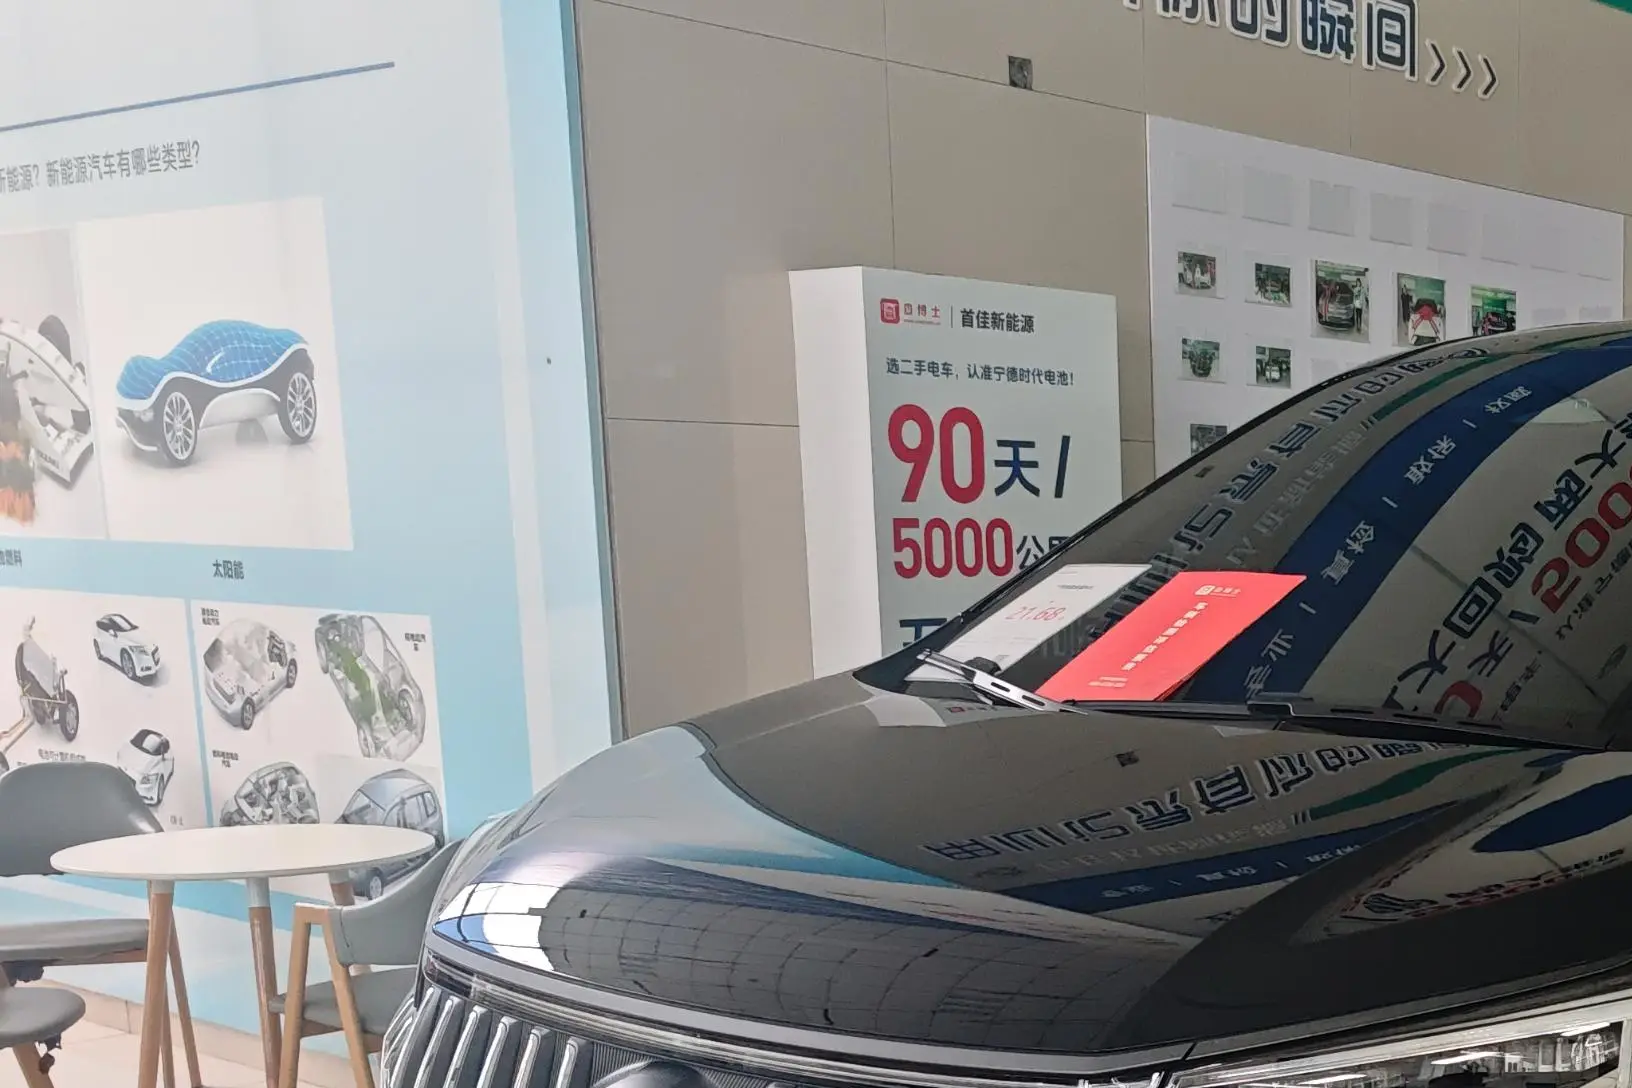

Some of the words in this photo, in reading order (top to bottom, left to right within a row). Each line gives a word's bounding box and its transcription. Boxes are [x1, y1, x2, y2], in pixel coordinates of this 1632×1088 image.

[1103, 0, 1420, 82] 的瞬间
[959, 307, 1036, 334] 首佳新能源
[212, 558, 245, 581] 太阳能
